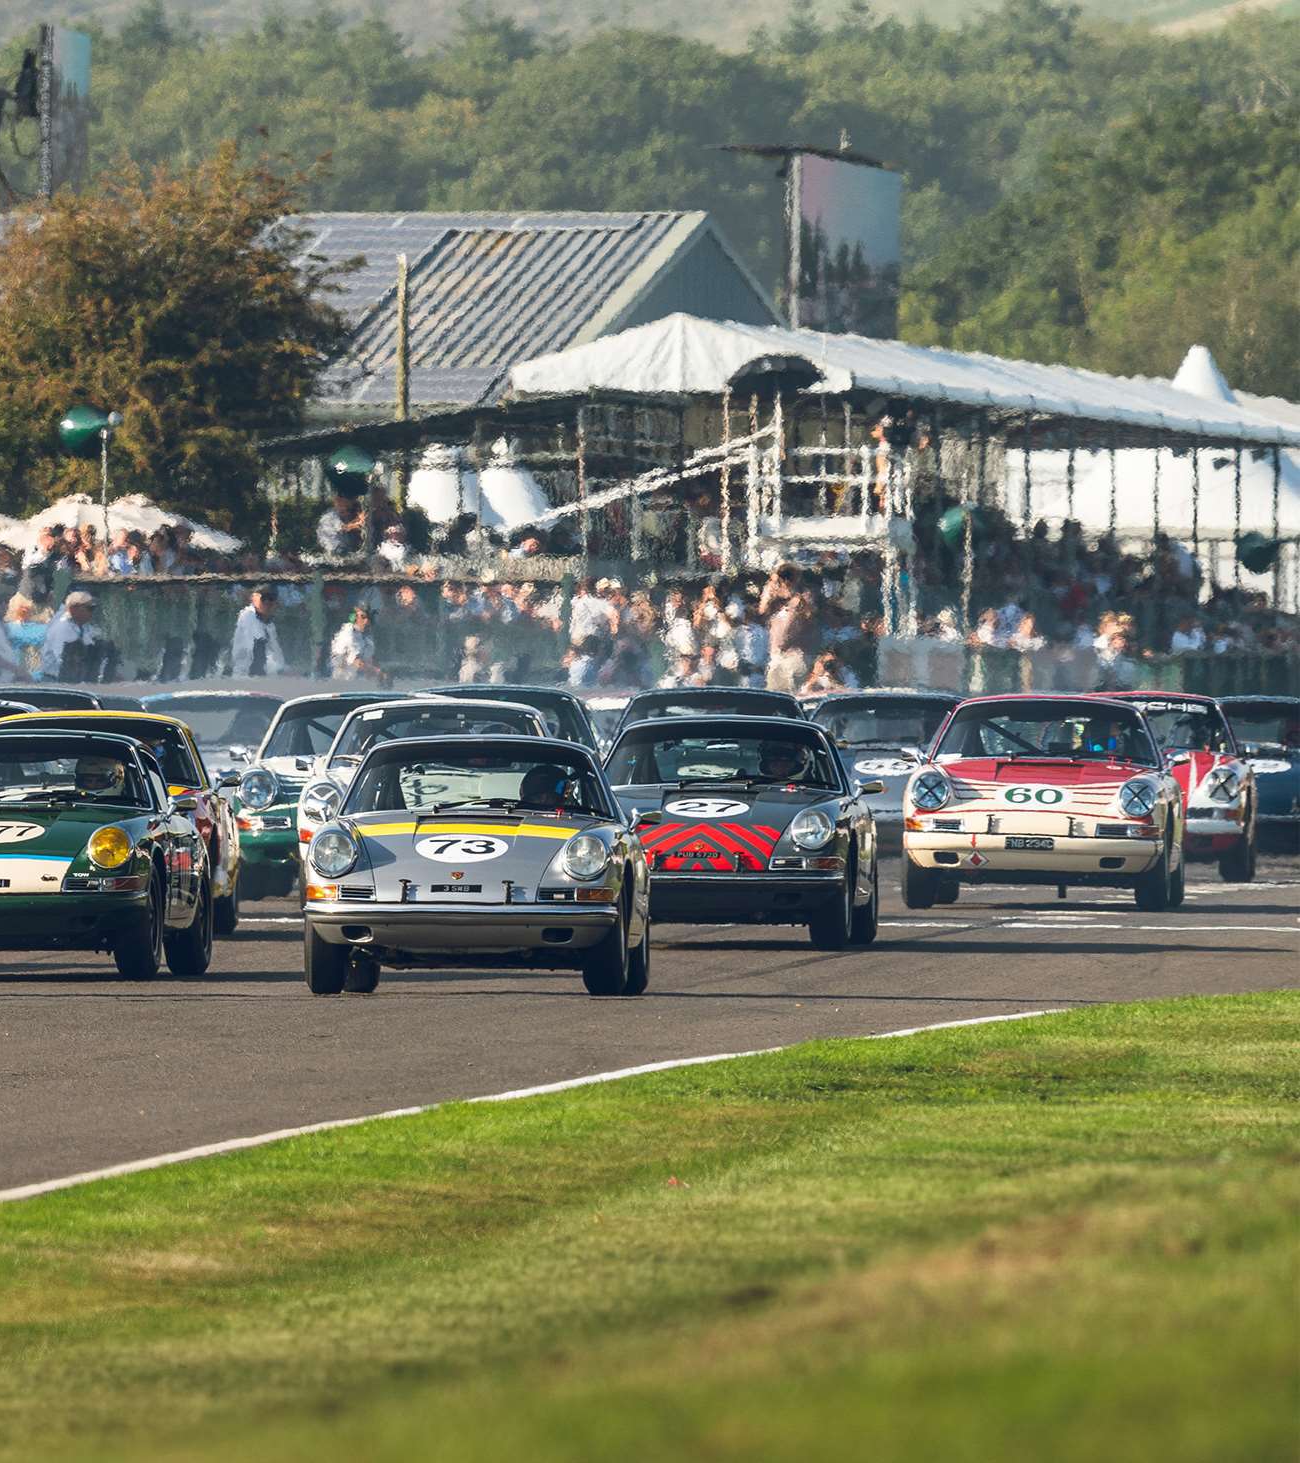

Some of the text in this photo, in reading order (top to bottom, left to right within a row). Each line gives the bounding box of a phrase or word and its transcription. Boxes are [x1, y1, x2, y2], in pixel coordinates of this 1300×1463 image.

[1005, 788, 1063, 804] 60
[676, 802, 740, 812] 27
[429, 840, 496, 854] 73
